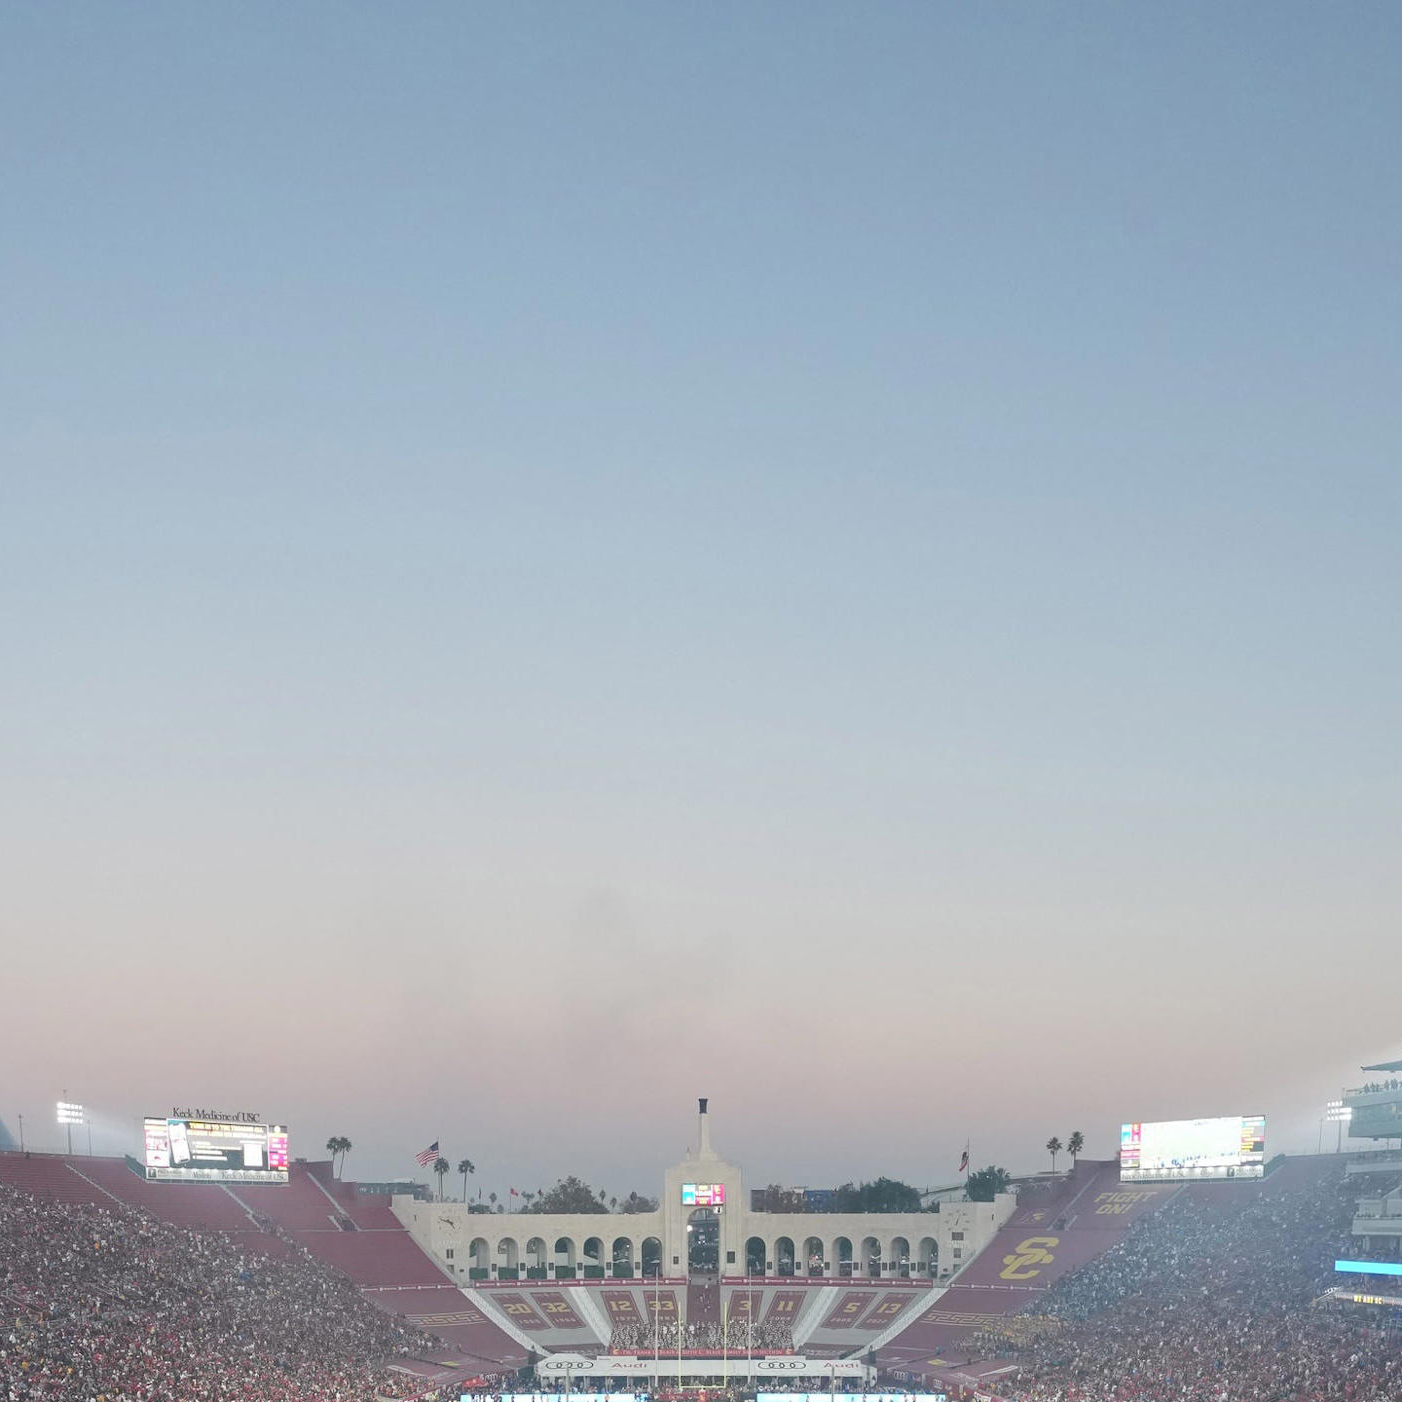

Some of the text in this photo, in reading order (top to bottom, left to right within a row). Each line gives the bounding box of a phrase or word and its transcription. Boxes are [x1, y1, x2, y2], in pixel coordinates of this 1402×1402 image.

[173, 1107, 260, 1122] Keck Medicine of USC
[1094, 1191, 1158, 1203] FIGHT
[1095, 1204, 1134, 1215] ON!
[503, 1303, 532, 1314] 20
[541, 1302, 569, 1313] 32
[611, 1300, 633, 1311] 12
[648, 1300, 674, 1311] 33
[776, 1301, 794, 1312] 11
[843, 1302, 862, 1313] 5
[877, 1302, 902, 1314] 13
